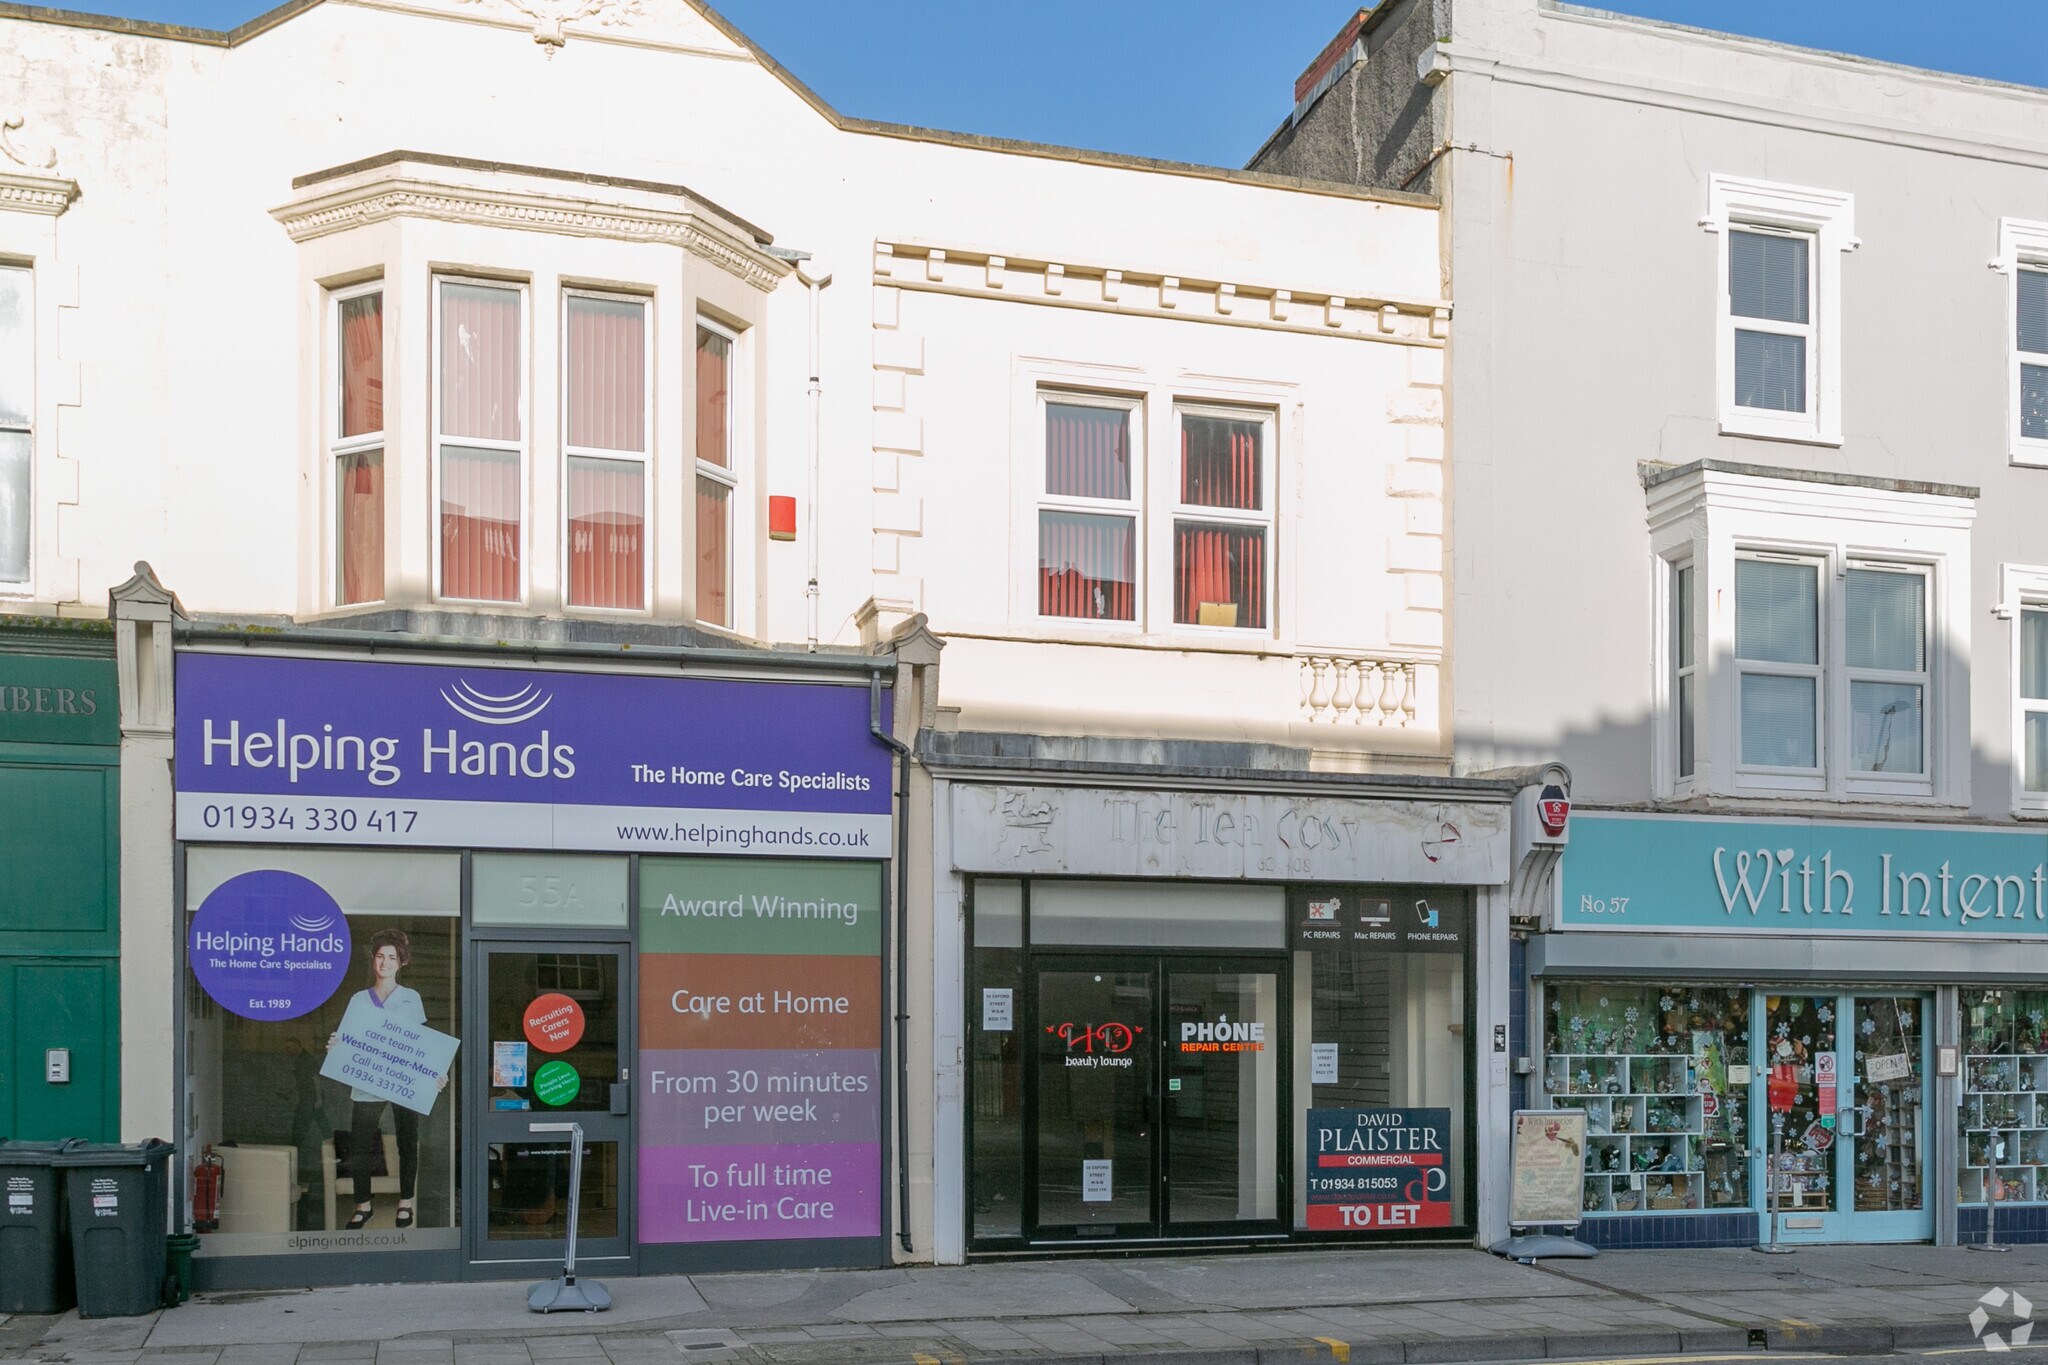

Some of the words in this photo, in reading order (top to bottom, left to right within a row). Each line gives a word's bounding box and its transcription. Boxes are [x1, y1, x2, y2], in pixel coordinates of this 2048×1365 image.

[203, 718, 401, 786] Helping
[423, 728, 576, 779] Hands
[631, 764, 665, 783] The
[671, 766, 725, 786] Home
[731, 768, 773, 788] Care
[778, 770, 871, 793] Specialists
[203, 805, 294, 830] 01934
[305, 808, 357, 832] 330
[366, 810, 418, 833] 417
[617, 823, 869, 848] www.helpinghands.co.uk
[519, 875, 584, 907] 55A
[1713, 847, 1853, 915] With
[661, 893, 743, 917] Award
[752, 895, 858, 925] Winning
[1579, 895, 1605, 913] No
[1609, 897, 1630, 914] 57
[196, 931, 275, 957] Helping
[281, 933, 344, 953] Hands
[1303, 931, 1313, 939] PC
[1314, 931, 1341, 939] REPAIRS
[1354, 932, 1368, 940] Mac
[1370, 932, 1396, 940] REPAIRS
[1407, 933, 1431, 941] PHONE
[1432, 933, 1458, 941] REPAIRS
[209, 959, 227, 968] The
[229, 959, 257, 969] Home
[260, 960, 281, 969] Care
[284, 960, 332, 971] Specialists
[249, 999, 266, 1008] Est.
[268, 999, 291, 1008] 1989
[671, 990, 730, 1013] Care
[739, 993, 765, 1013] at
[774, 991, 849, 1014] Home
[528, 1004, 574, 1027] Recruiting
[541, 1017, 569, 1033] Carers
[381, 1019, 402, 1034] Join
[404, 1029, 421, 1041] our
[549, 1030, 570, 1042] Now
[1181, 1022, 1264, 1041] PHONE
[365, 1029, 389, 1043] care
[388, 1037, 414, 1054] team
[415, 1050, 425, 1058] in
[1181, 1043, 1219, 1052] REPAIR
[1222, 1043, 1265, 1052] CENTRE
[341, 1033, 439, 1079] Weston-super-Mare
[352, 1053, 372, 1067] Call
[372, 1062, 384, 1073] us
[1065, 1056, 1098, 1069] beauty
[1100, 1056, 1133, 1069] lounge
[1875, 1058, 1898, 1070] OPEN
[342, 1064, 375, 1084] 01934
[376, 1077, 416, 1099] 331702
[651, 1071, 717, 1094] From
[726, 1070, 759, 1093] 30
[767, 1071, 868, 1092] minutes
[704, 1105, 745, 1129] per
[753, 1098, 817, 1121] week
[1357, 1114, 1402, 1127] DAVID
[1318, 1128, 1442, 1152] PLAISTER
[1347, 1156, 1415, 1165] COMMERCIAL
[688, 1165, 719, 1187] To
[726, 1163, 766, 1186] full
[774, 1165, 832, 1185] time
[1311, 1179, 1318, 1190] T
[1320, 1179, 1354, 1190] 01934
[1357, 1178, 1398, 1189] 815053
[687, 1199, 768, 1222] Live-in
[777, 1196, 834, 1219] Care
[1339, 1205, 1372, 1226] TO
[1377, 1204, 1421, 1225] LET
